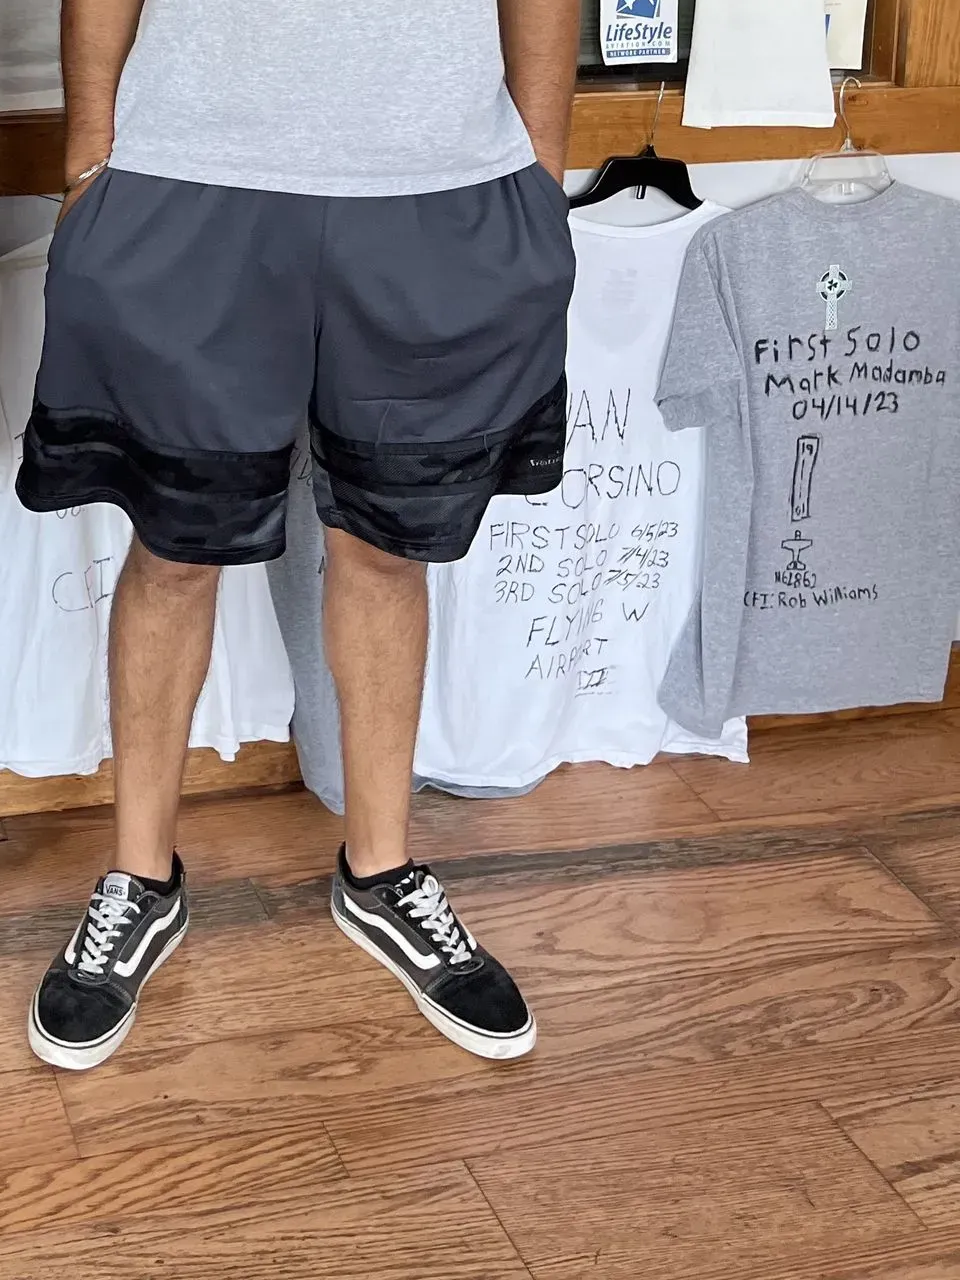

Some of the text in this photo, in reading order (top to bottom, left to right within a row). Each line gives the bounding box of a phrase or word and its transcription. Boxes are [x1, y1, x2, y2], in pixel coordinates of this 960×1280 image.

[606, 21, 673, 44] LifeStyle
[608, 48, 667, 57] NETWORK PARTNER
[754, 325, 920, 365] First Solo
[764, 358, 946, 396] Mark Madamba
[792, 390, 900, 421] 04/14/23
[802, 441, 813, 455] 19
[489, 520, 679, 551] FIRST SOLO 6/5/23
[496, 546, 670, 578] 2ND SOLO 7/4/23
[494, 580, 535, 604] 3RD
[548, 571, 602, 604] SOLO
[744, 584, 879, 610] CFI: Rob Williams
[622, 602, 649, 622] W
[106, 884, 123, 896] VANS
